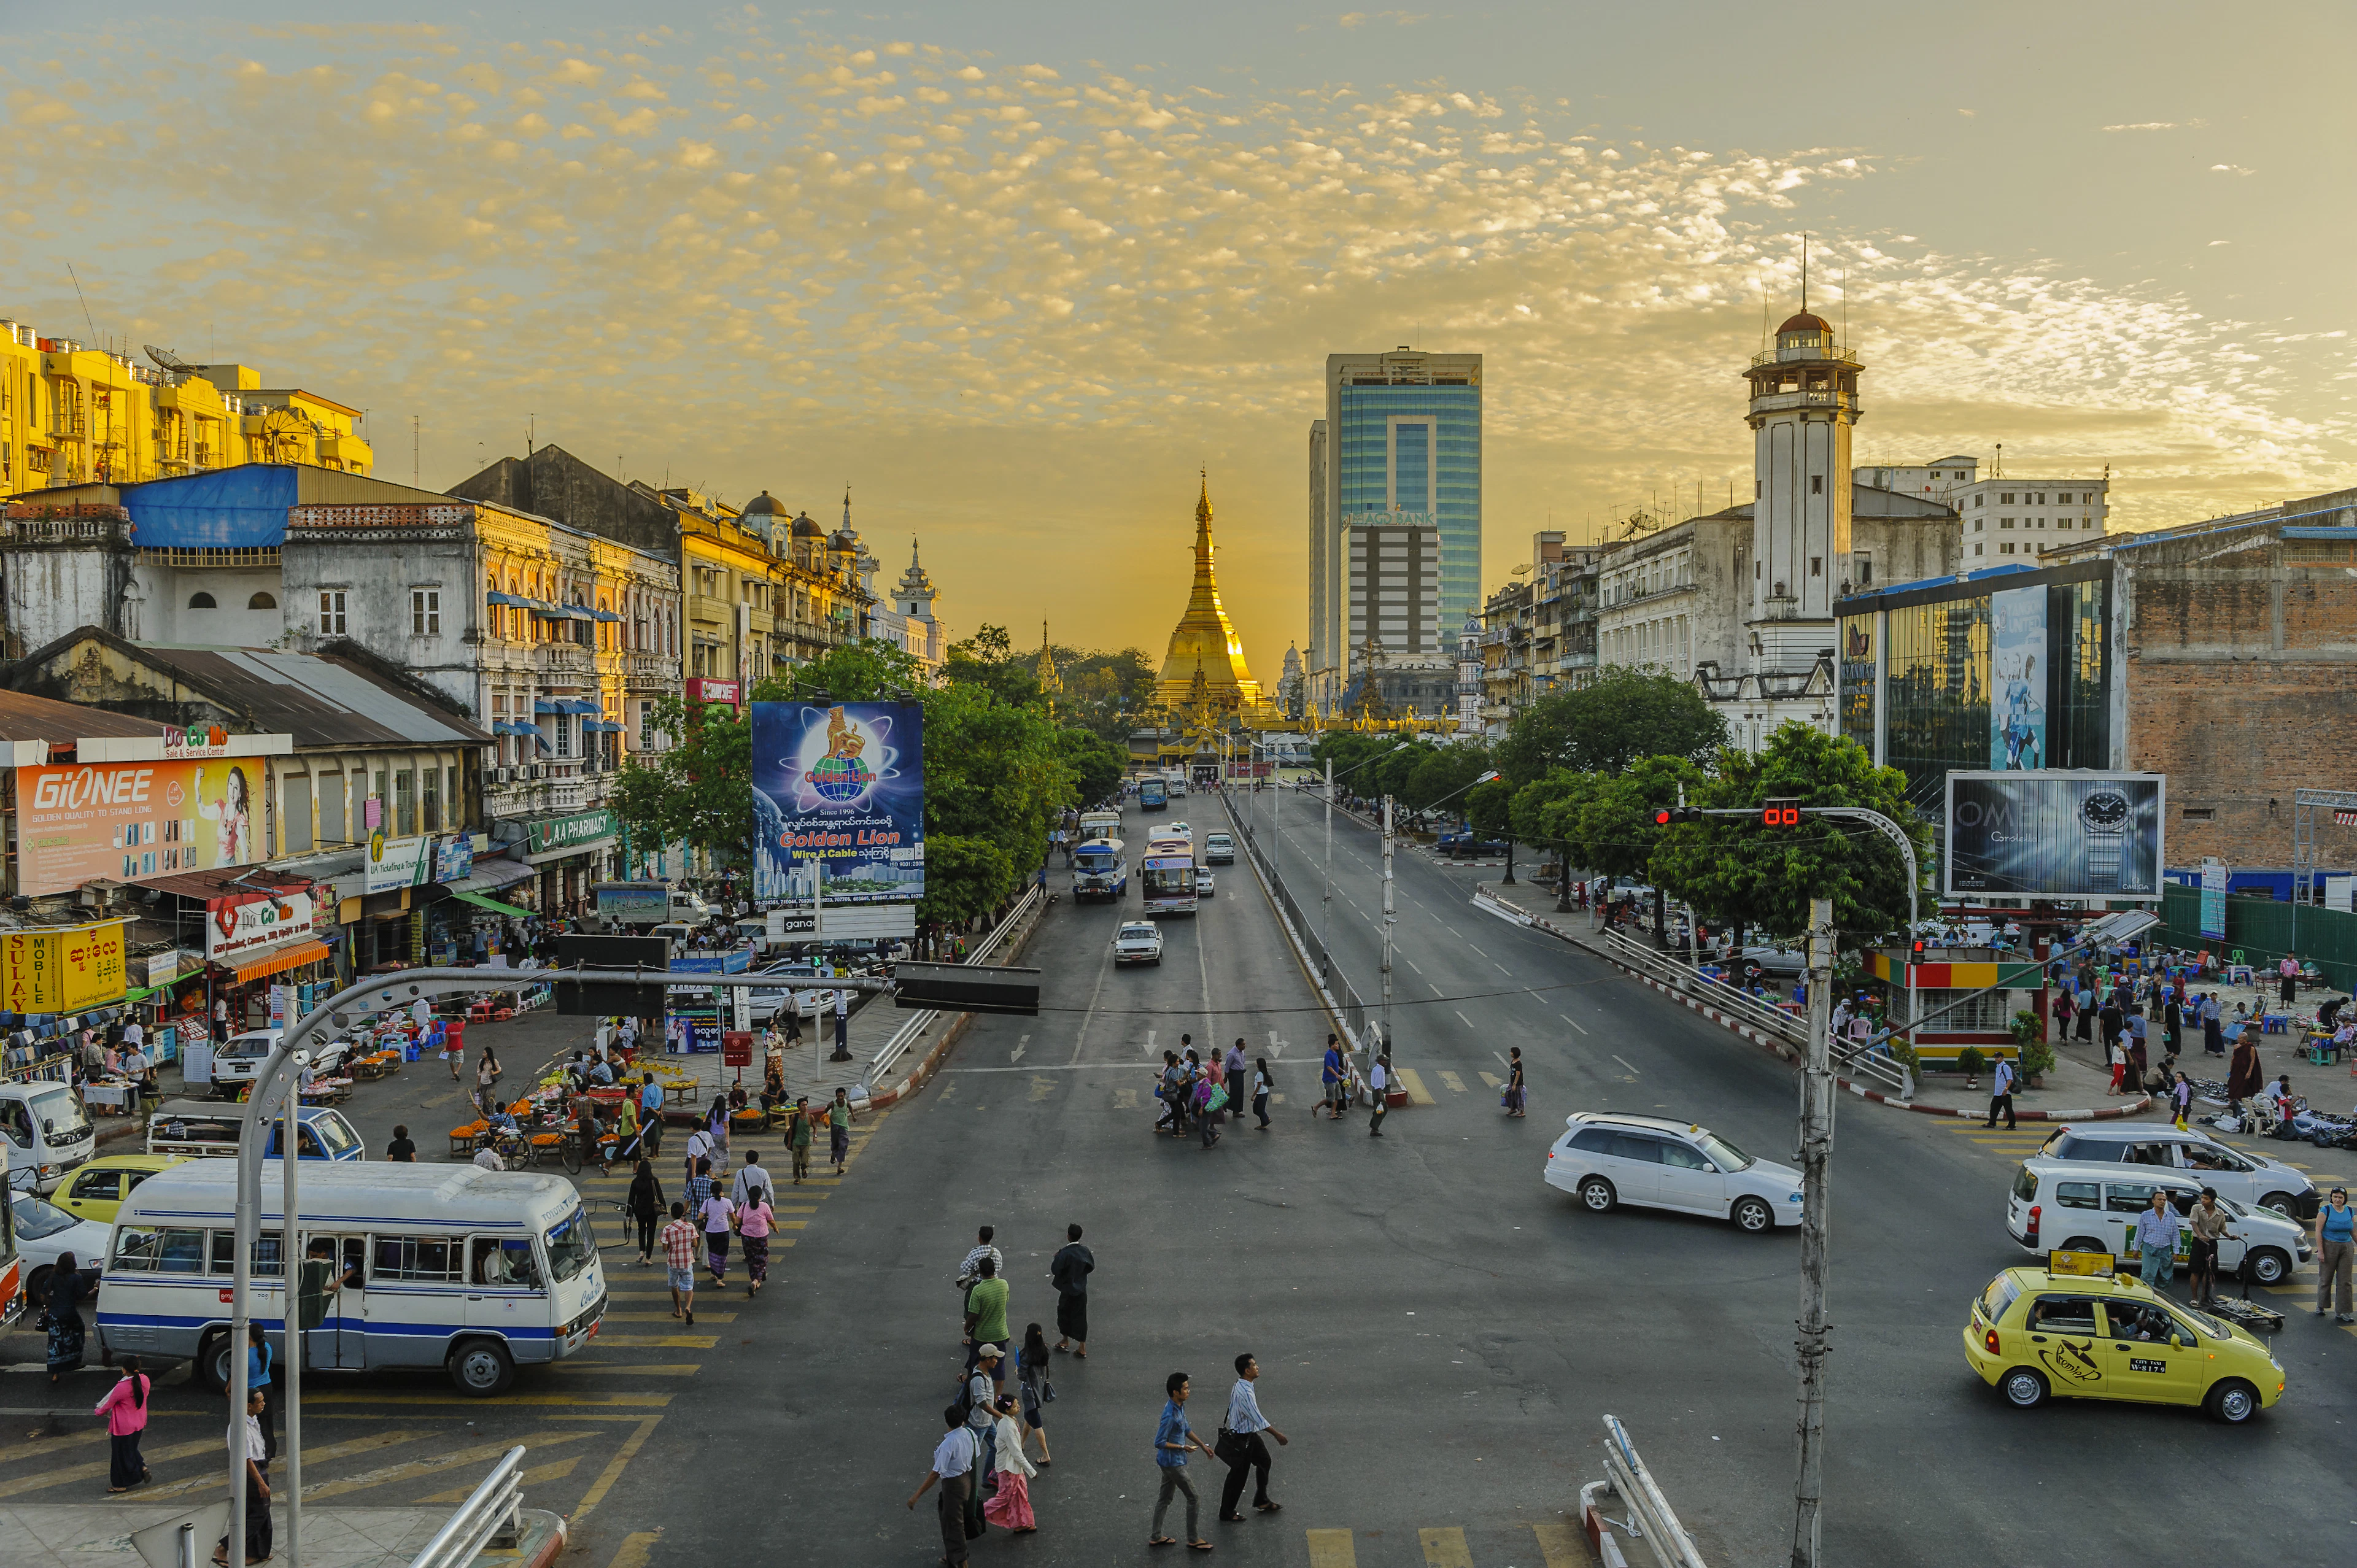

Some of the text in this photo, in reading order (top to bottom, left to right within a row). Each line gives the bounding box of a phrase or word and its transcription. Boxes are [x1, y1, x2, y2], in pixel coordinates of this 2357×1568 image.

[1366, 512, 1434, 524] AGD BANK
[163, 725, 228, 747] Do Co Mo
[166, 747, 225, 758] Sale & Service Center
[804, 768, 877, 783] Golden Lion
[32, 805, 152, 823] GOLDEN QUALITY TO STAND LONG
[567, 815, 608, 840] PHARMACY
[54, 836, 69, 846] SOURCE
[780, 829, 900, 848] Golden Lion
[792, 850, 817, 859] Wire
[818, 849, 826, 859] &
[827, 849, 857, 858] Cable
[371, 865, 378, 875] UA
[379, 862, 400, 873] Ticketing
[405, 860, 417, 869] Tours
[261, 907, 275, 925] Co
[279, 903, 293, 921] Mo
[9, 935, 27, 1013] SULAY
[34, 938, 45, 1004] MOBILE
[55, 1138, 92, 1156] KHAING KHAING
[66, 1134, 82, 1143] JAC
[541, 1203, 565, 1222] TOYOTA
